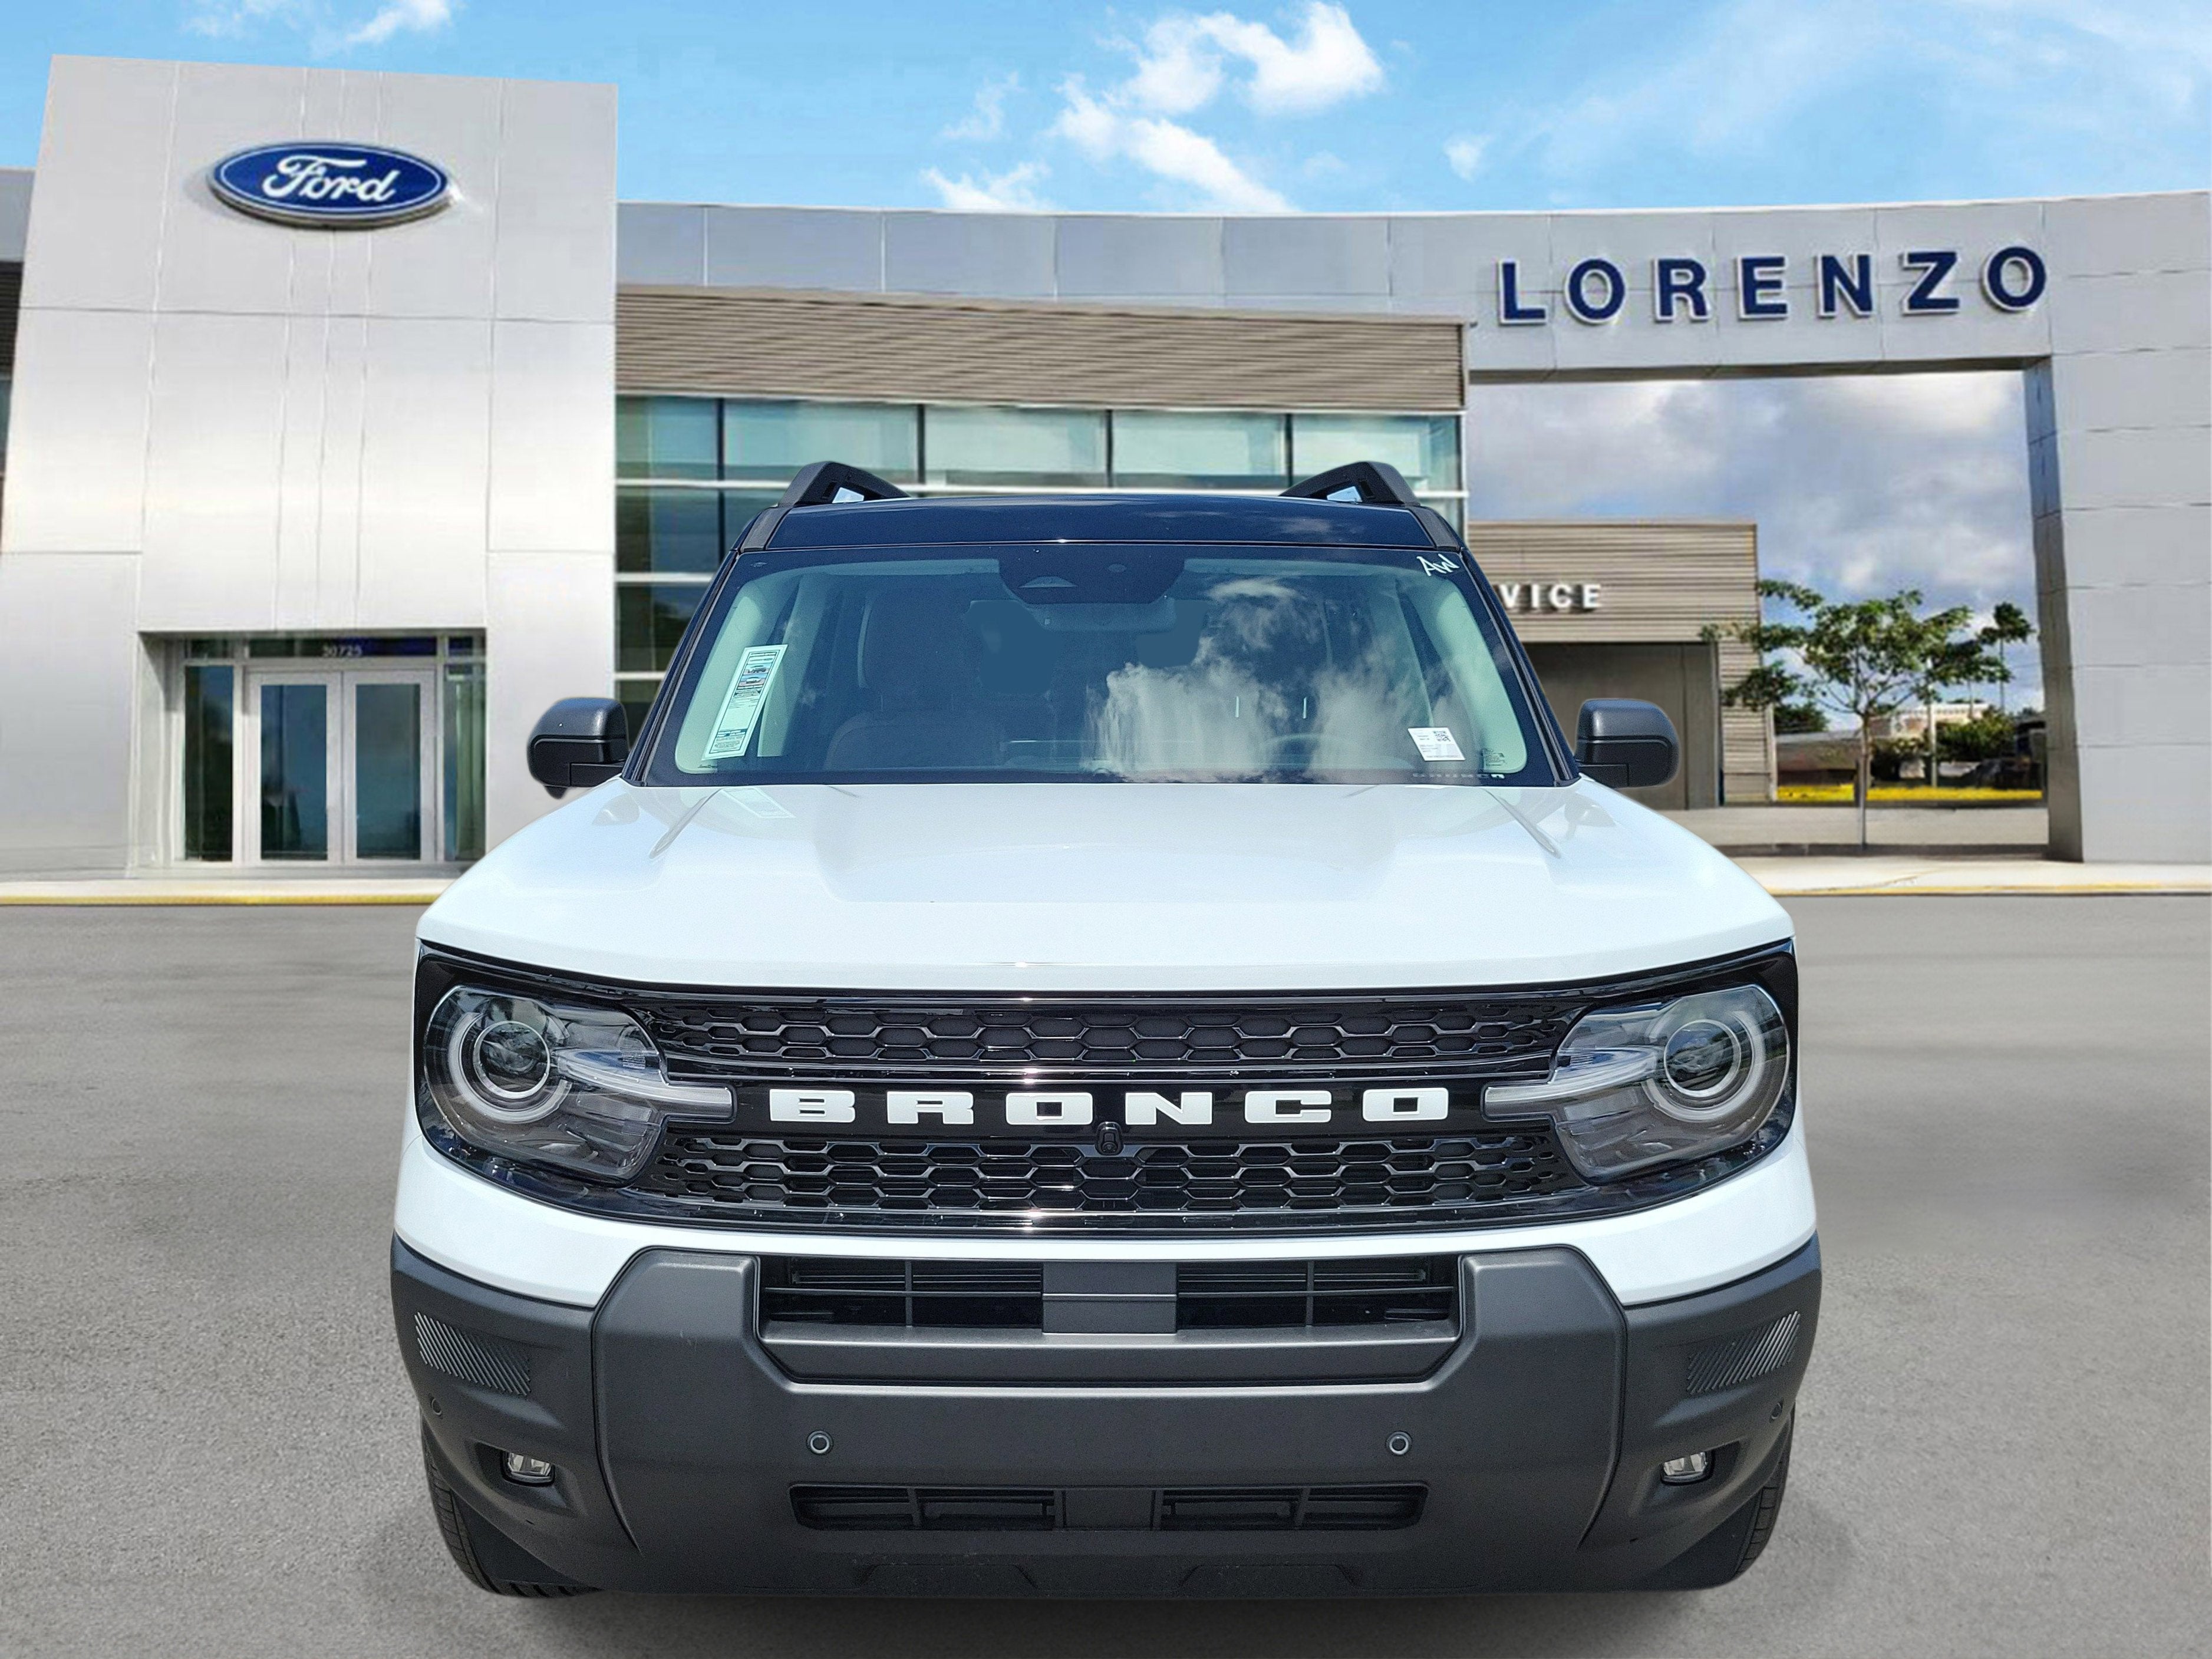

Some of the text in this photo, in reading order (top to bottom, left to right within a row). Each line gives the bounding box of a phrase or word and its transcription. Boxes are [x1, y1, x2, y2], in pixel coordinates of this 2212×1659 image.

[262, 154, 400, 202] Ford
[1497, 246, 2047, 324] LORENZO
[1499, 583, 1602, 609] VICE
[769, 1087, 1449, 1126] BRONCO
